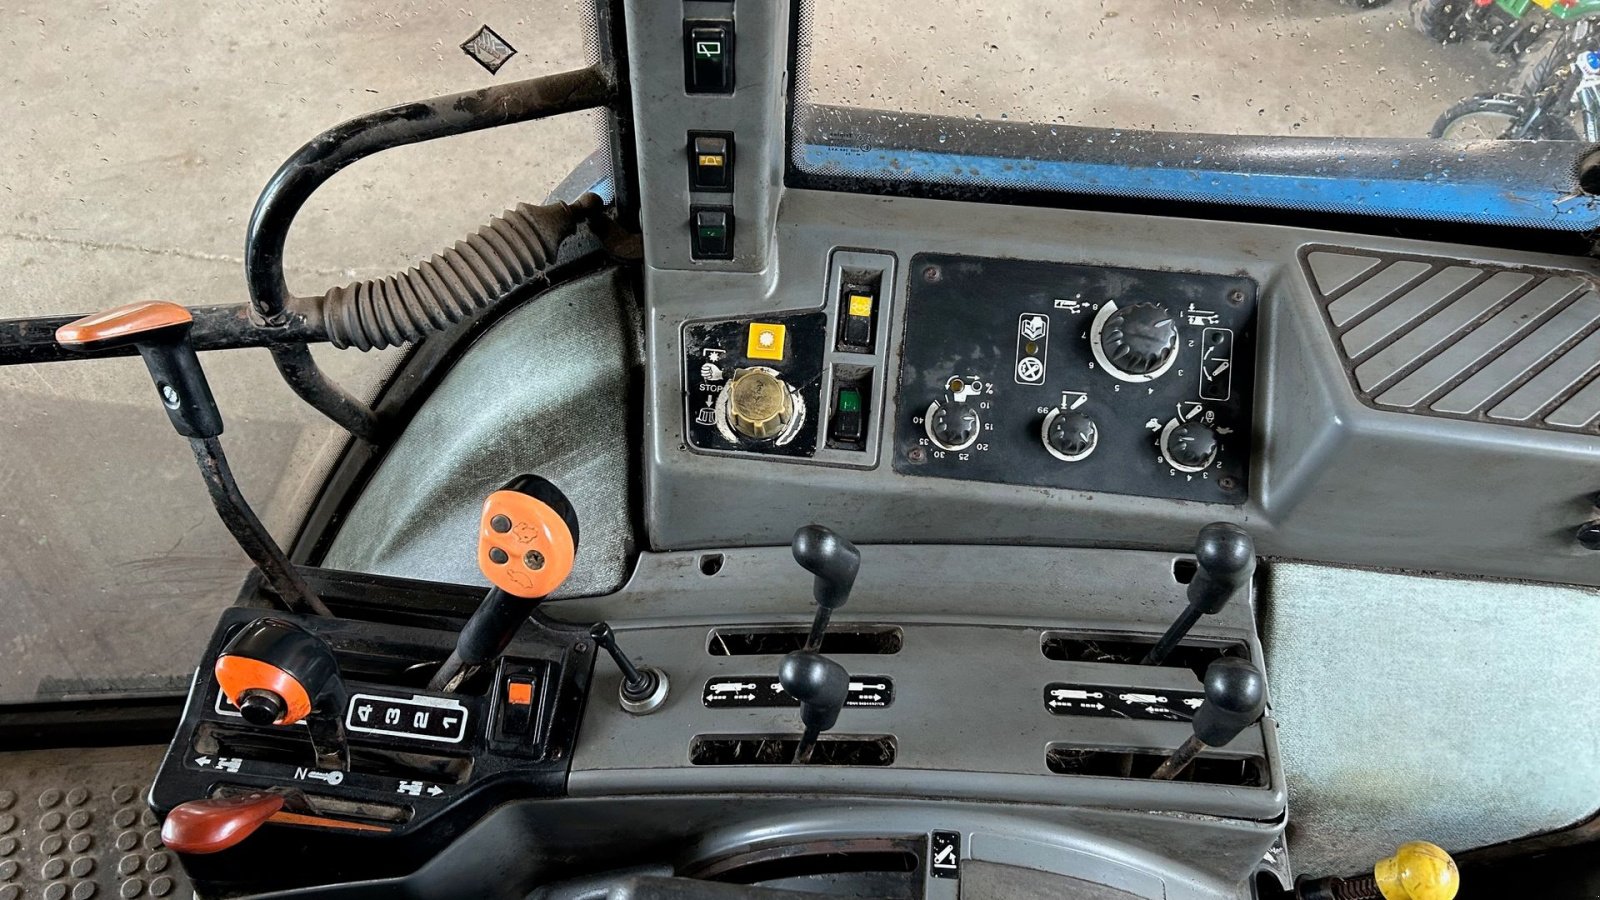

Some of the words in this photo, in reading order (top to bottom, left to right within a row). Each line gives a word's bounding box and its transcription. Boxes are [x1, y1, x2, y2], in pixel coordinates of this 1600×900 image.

[1081, 331, 1087, 339] 7
[699, 384, 724, 392] STOP
[984, 423, 994, 431] 15
[919, 438, 929, 446] 35
[958, 453, 969, 461] 25
[357, 704, 373, 722] 4
[385, 708, 400, 724] 3
[413, 711, 430, 729] 2
[442, 717, 458, 729] 1
[294, 767, 308, 780] N
